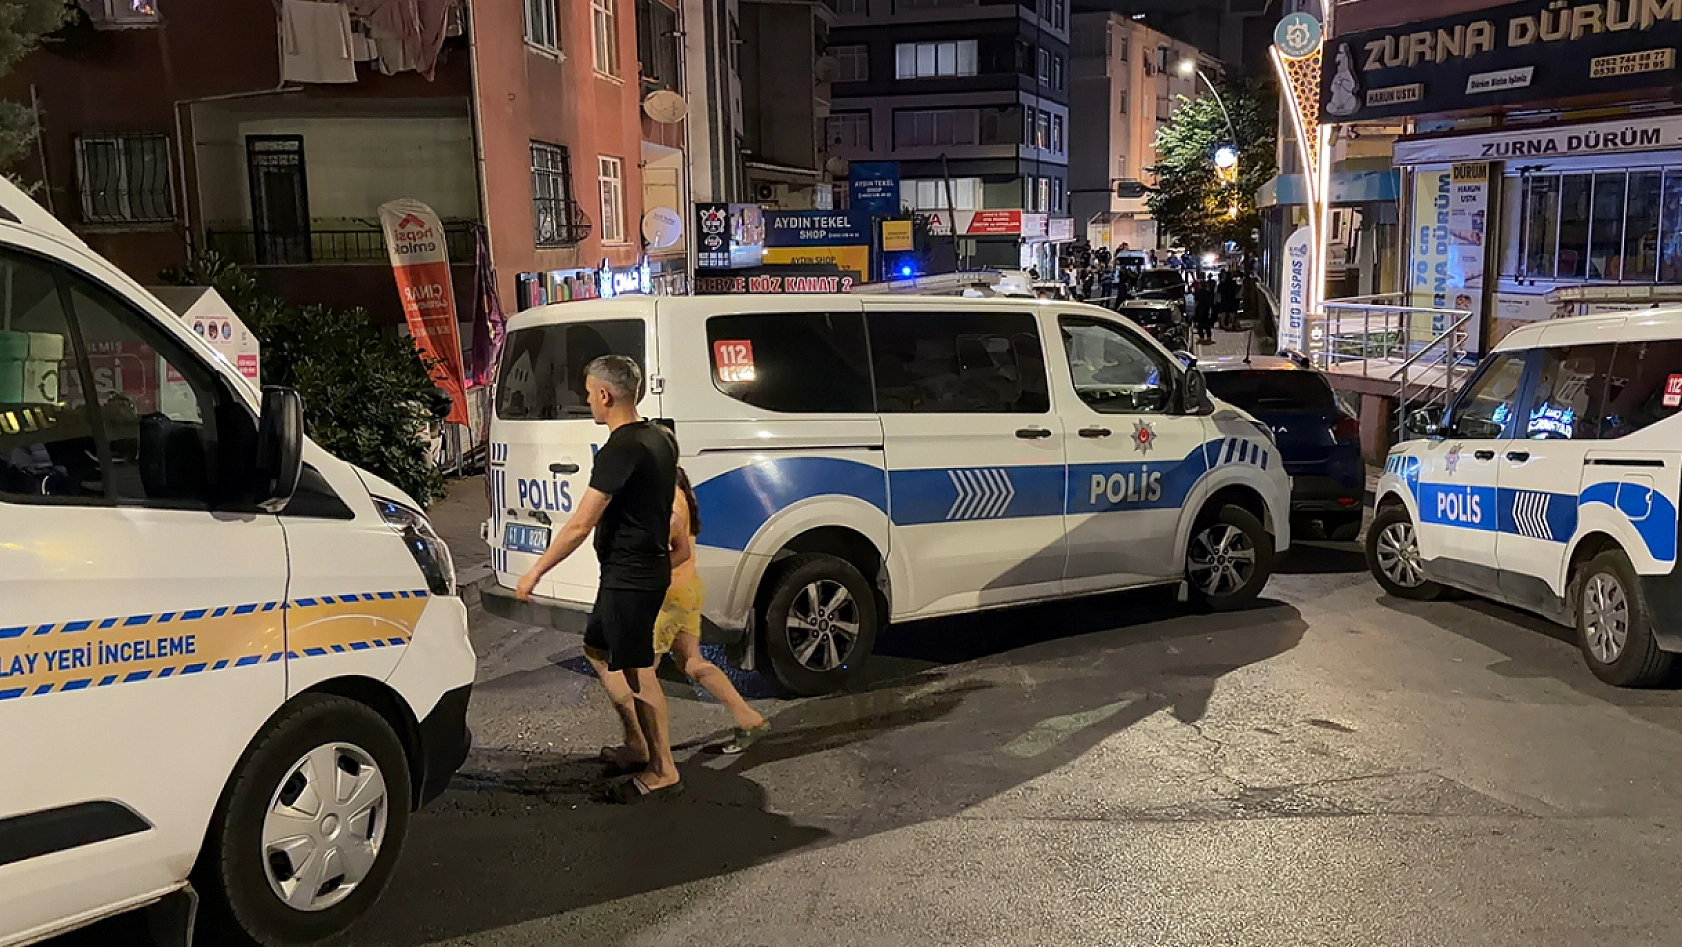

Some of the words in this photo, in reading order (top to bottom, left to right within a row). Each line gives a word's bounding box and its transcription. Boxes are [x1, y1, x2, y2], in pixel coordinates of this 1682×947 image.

[1363, 20, 1494, 72] ZURNA
[1508, 0, 1682, 48] DÜRÜM
[1619, 64, 1636, 73] 702
[1369, 90, 1394, 102] HARUN
[1395, 88, 1417, 100] USTA
[1481, 138, 1559, 157] ZURNA
[1566, 126, 1661, 150] DÜRÜM
[774, 216, 814, 229] AYDIN
[814, 215, 851, 228] TEKEL
[1433, 173, 1450, 255] DÜRÜM
[799, 230, 827, 240] SHOP
[1420, 225, 1430, 256] cm
[815, 256, 837, 264] SHOP
[1416, 260, 1429, 286] 70
[749, 275, 783, 293] KÖZ
[784, 277, 840, 293] KANAT
[841, 277, 853, 293] 2
[1291, 260, 1303, 305] PASPAS
[1289, 307, 1302, 329] OTO
[720, 344, 748, 364] 112
[1667, 377, 1682, 393] 112
[518, 471, 573, 513] POLİS
[1090, 464, 1161, 504] POLİS
[1437, 486, 1482, 524] POLİS
[43, 642, 92, 672] YERİ
[97, 634, 196, 665] İNCELEME
